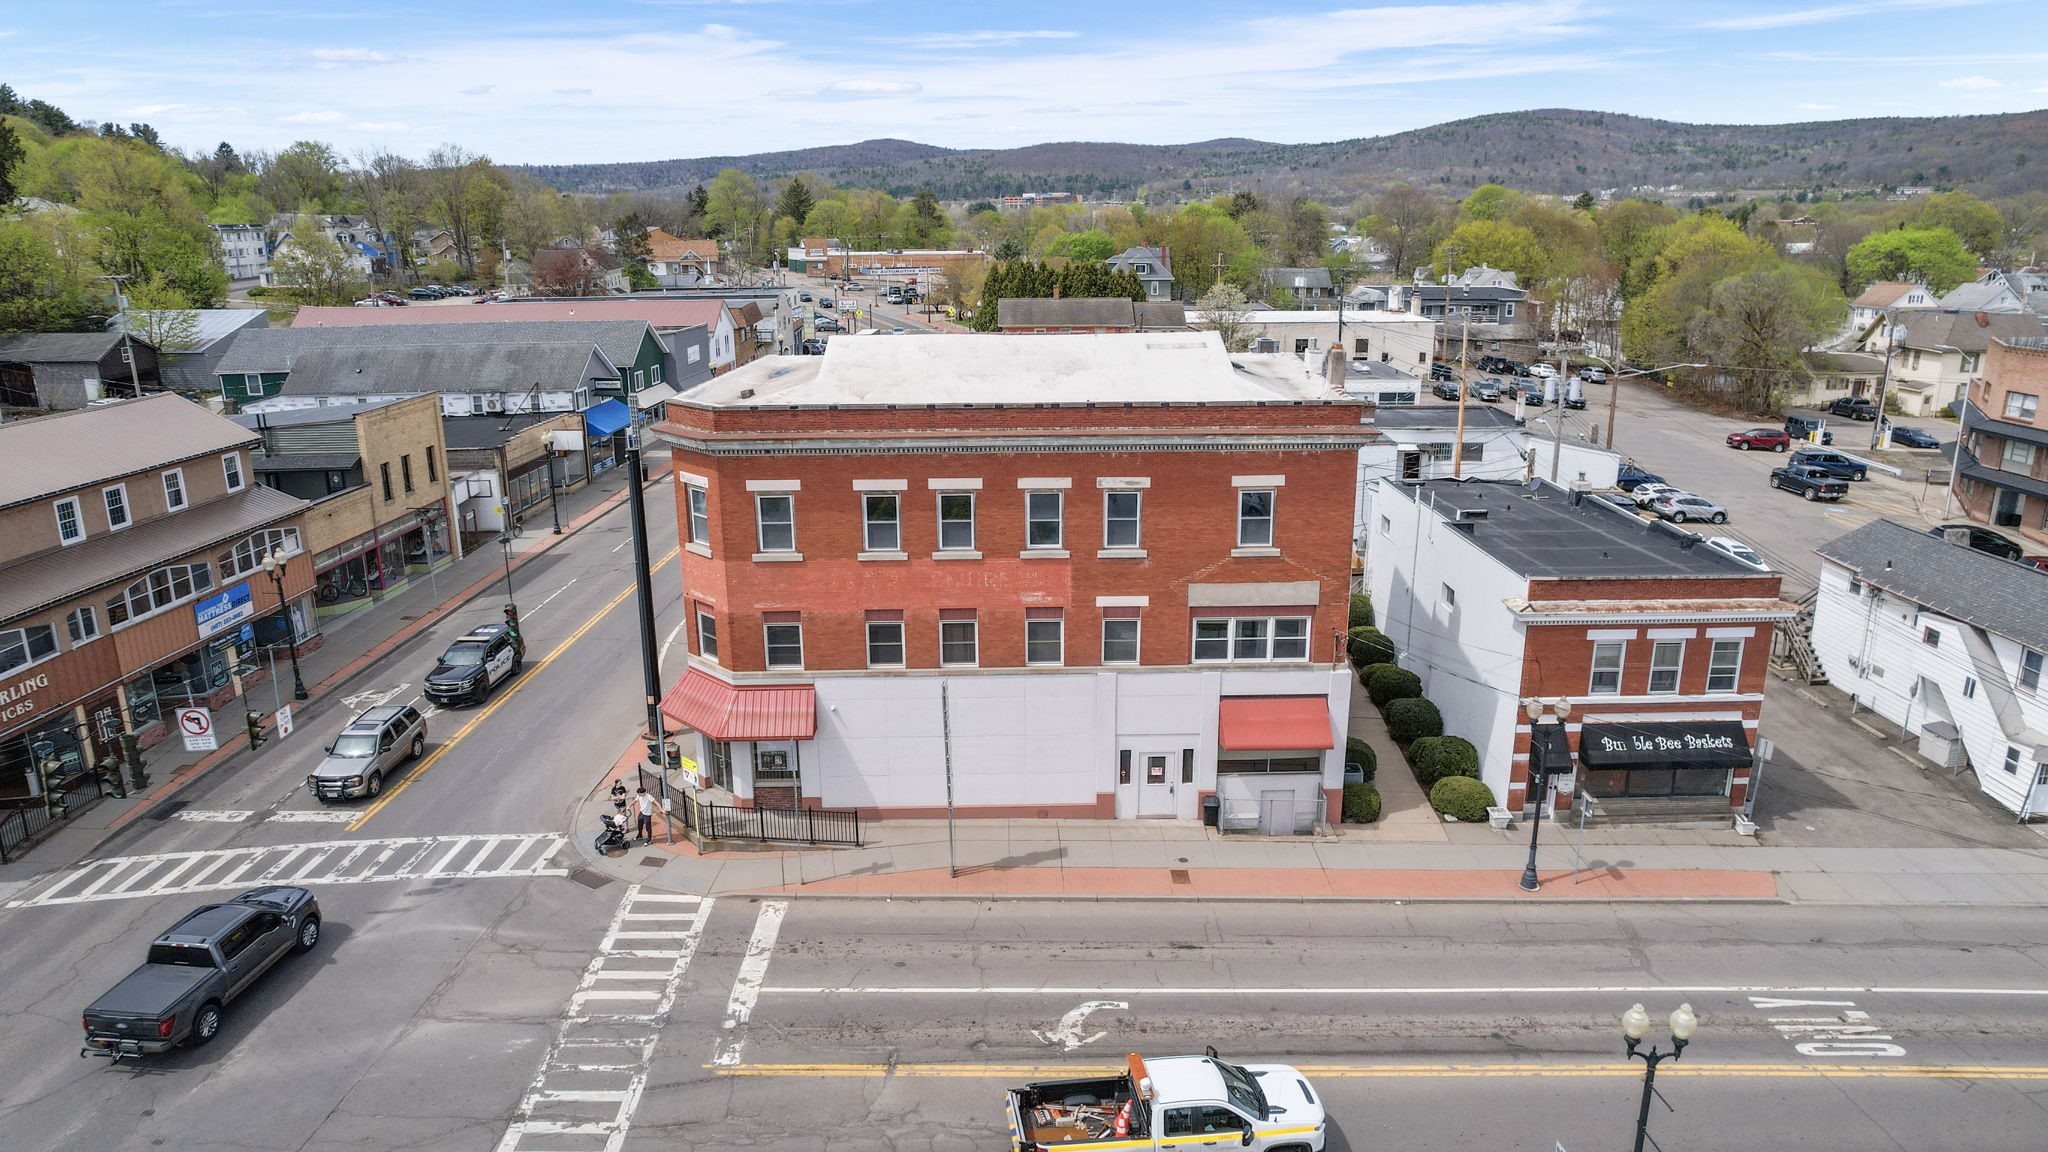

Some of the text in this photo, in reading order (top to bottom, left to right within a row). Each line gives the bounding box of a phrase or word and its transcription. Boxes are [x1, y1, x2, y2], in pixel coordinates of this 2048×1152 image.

[489, 654, 512, 676] POLICE
[1655, 736, 1682, 751] Bee
[1684, 733, 1733, 749] Baskets
